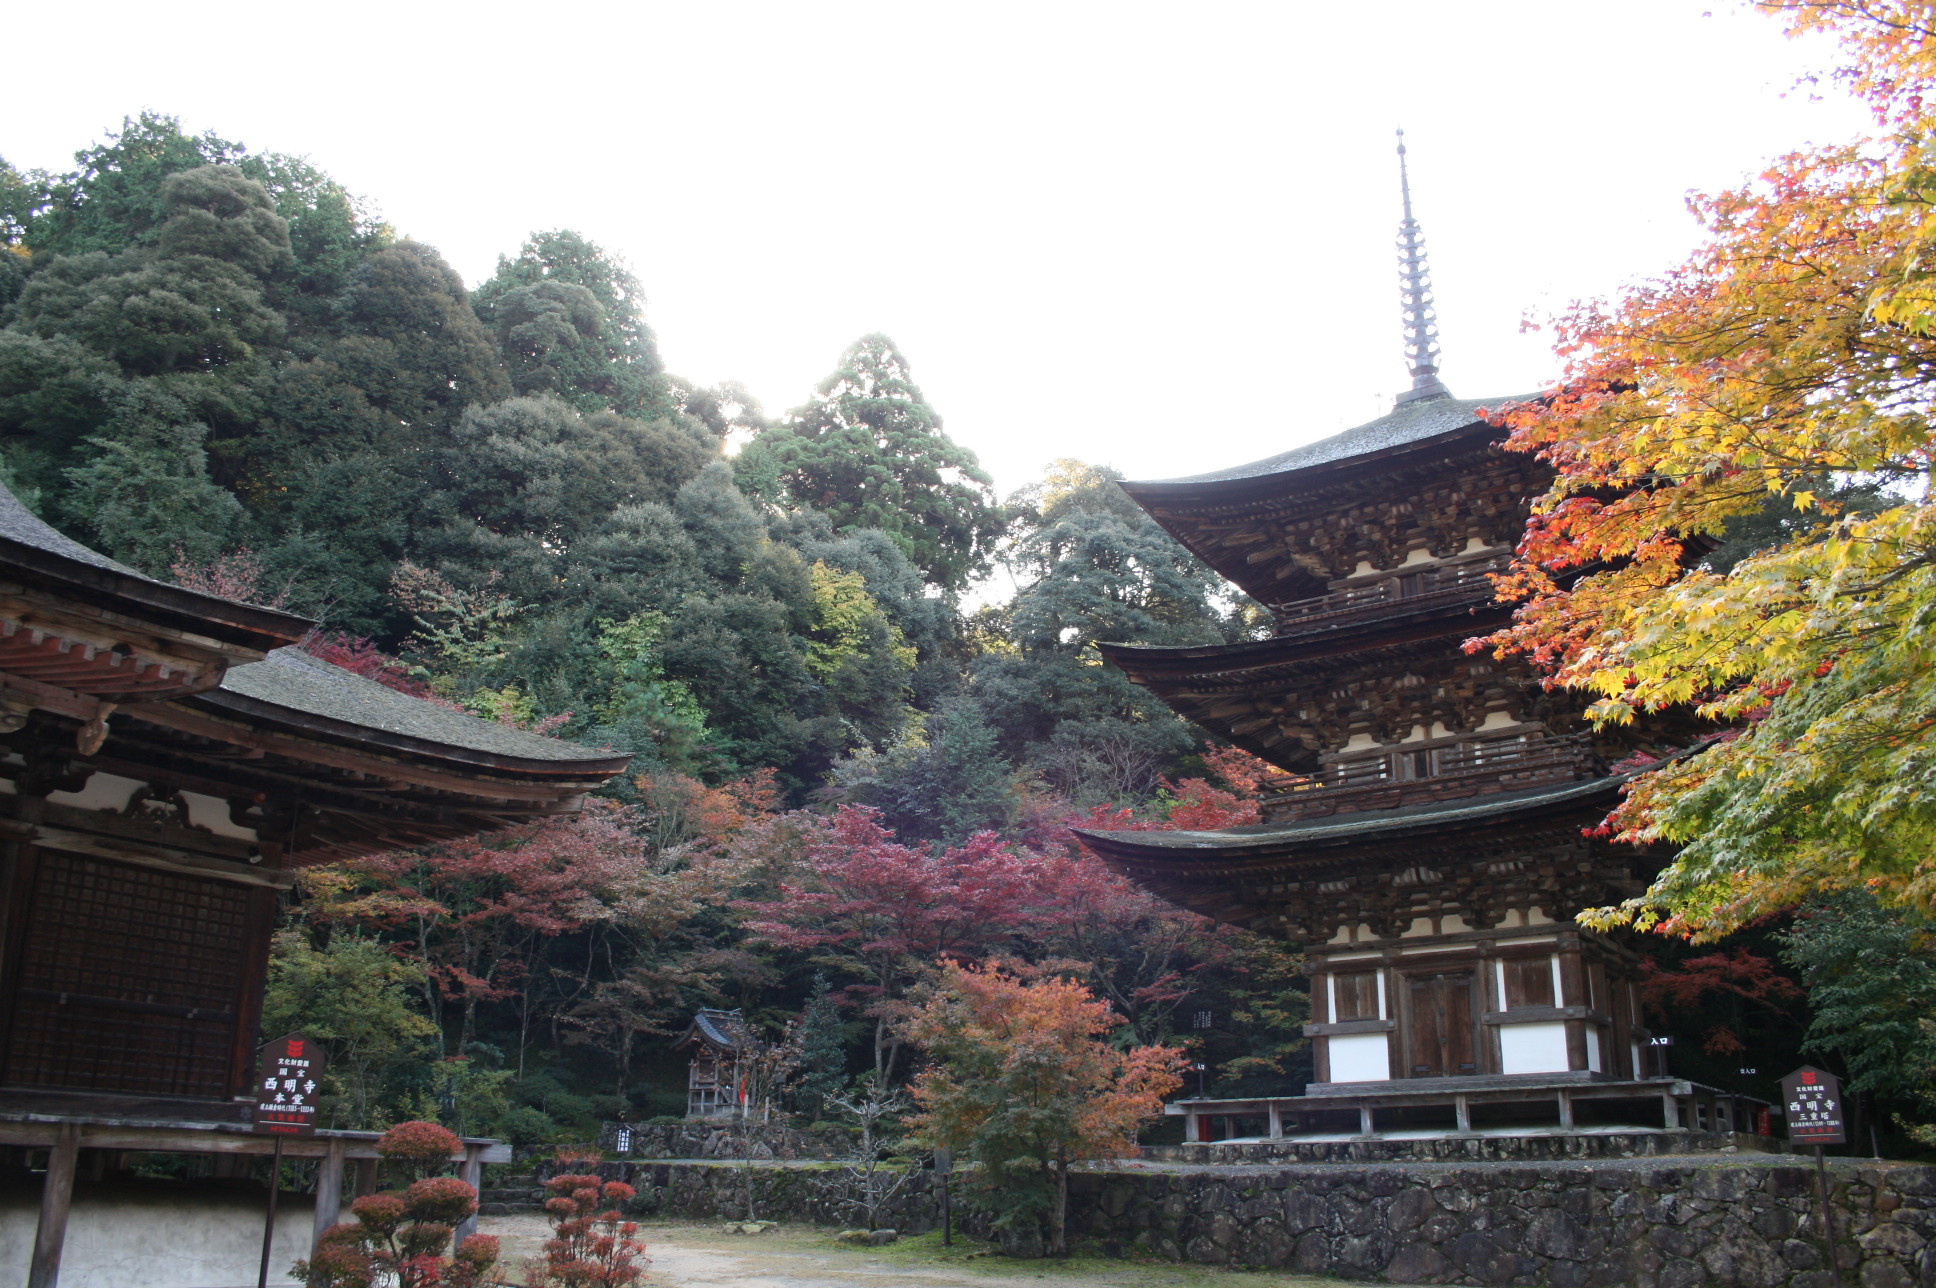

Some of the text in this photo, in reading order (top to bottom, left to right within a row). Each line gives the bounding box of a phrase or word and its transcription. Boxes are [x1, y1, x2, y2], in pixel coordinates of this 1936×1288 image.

[1650, 1037, 1668, 1045] 入口
[264, 1077, 316, 1094] 西明寺
[273, 1092, 305, 1105] 本堂
[1790, 1100, 1835, 1111] 西明寺
[1799, 1112, 1829, 1120] 三重塔
